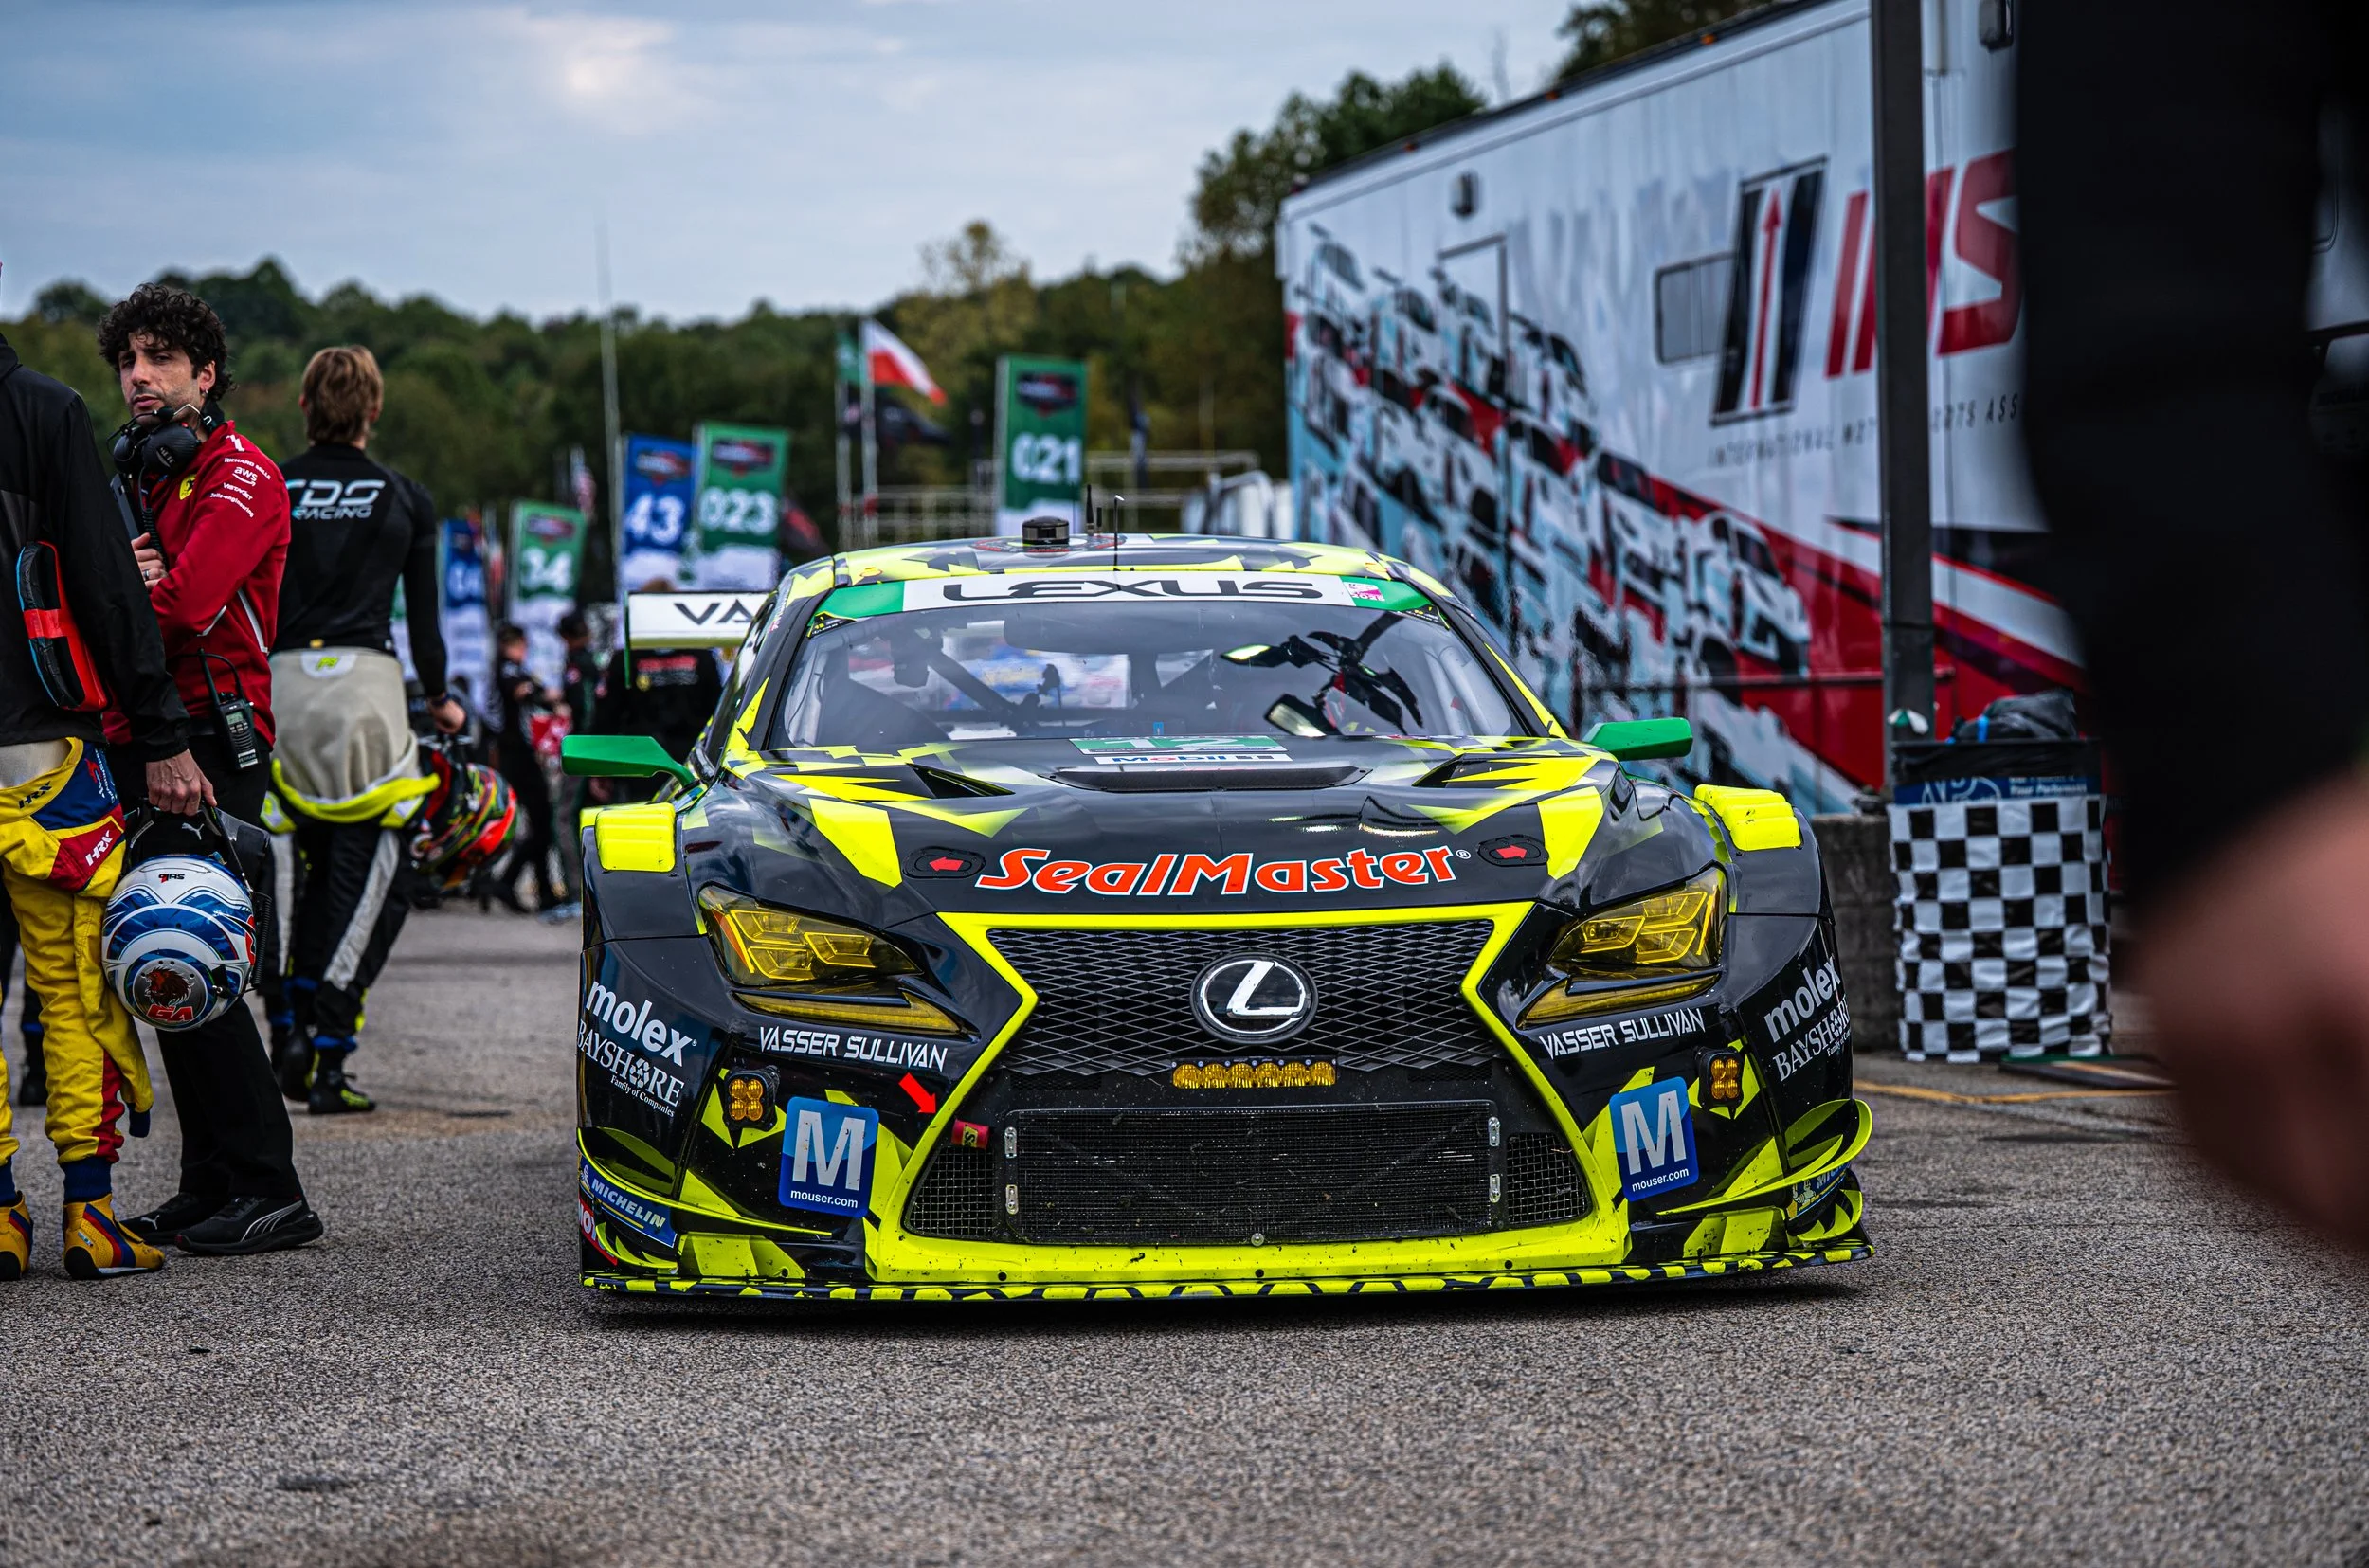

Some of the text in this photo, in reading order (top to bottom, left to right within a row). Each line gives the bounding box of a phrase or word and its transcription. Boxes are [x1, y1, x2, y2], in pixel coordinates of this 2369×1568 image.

[224, 458, 271, 480] RICHARD MILLE
[234, 466, 259, 482] aws
[1011, 432, 1082, 484] 021
[624, 493, 684, 545] 43
[699, 486, 779, 536] 023
[943, 579, 1323, 601] LEXUS
[18, 780, 52, 809] HRX
[85, 829, 113, 866] HRX
[586, 981, 693, 1067] molex
[1763, 956, 1841, 1043] molex
[760, 1026, 948, 1072] VASSER SULLIVAN
[1539, 1007, 1706, 1060] VASSER SULLIVAN
[577, 1018, 685, 1108] BAYSHORE
[610, 1074, 676, 1118] Family of Companies
[792, 1109, 866, 1191] M
[1620, 1090, 1687, 1176] M
[591, 1178, 666, 1229] MICHELIN
[790, 1189, 859, 1209] mouser.com
[1631, 1167, 1690, 1193] mouser.com
